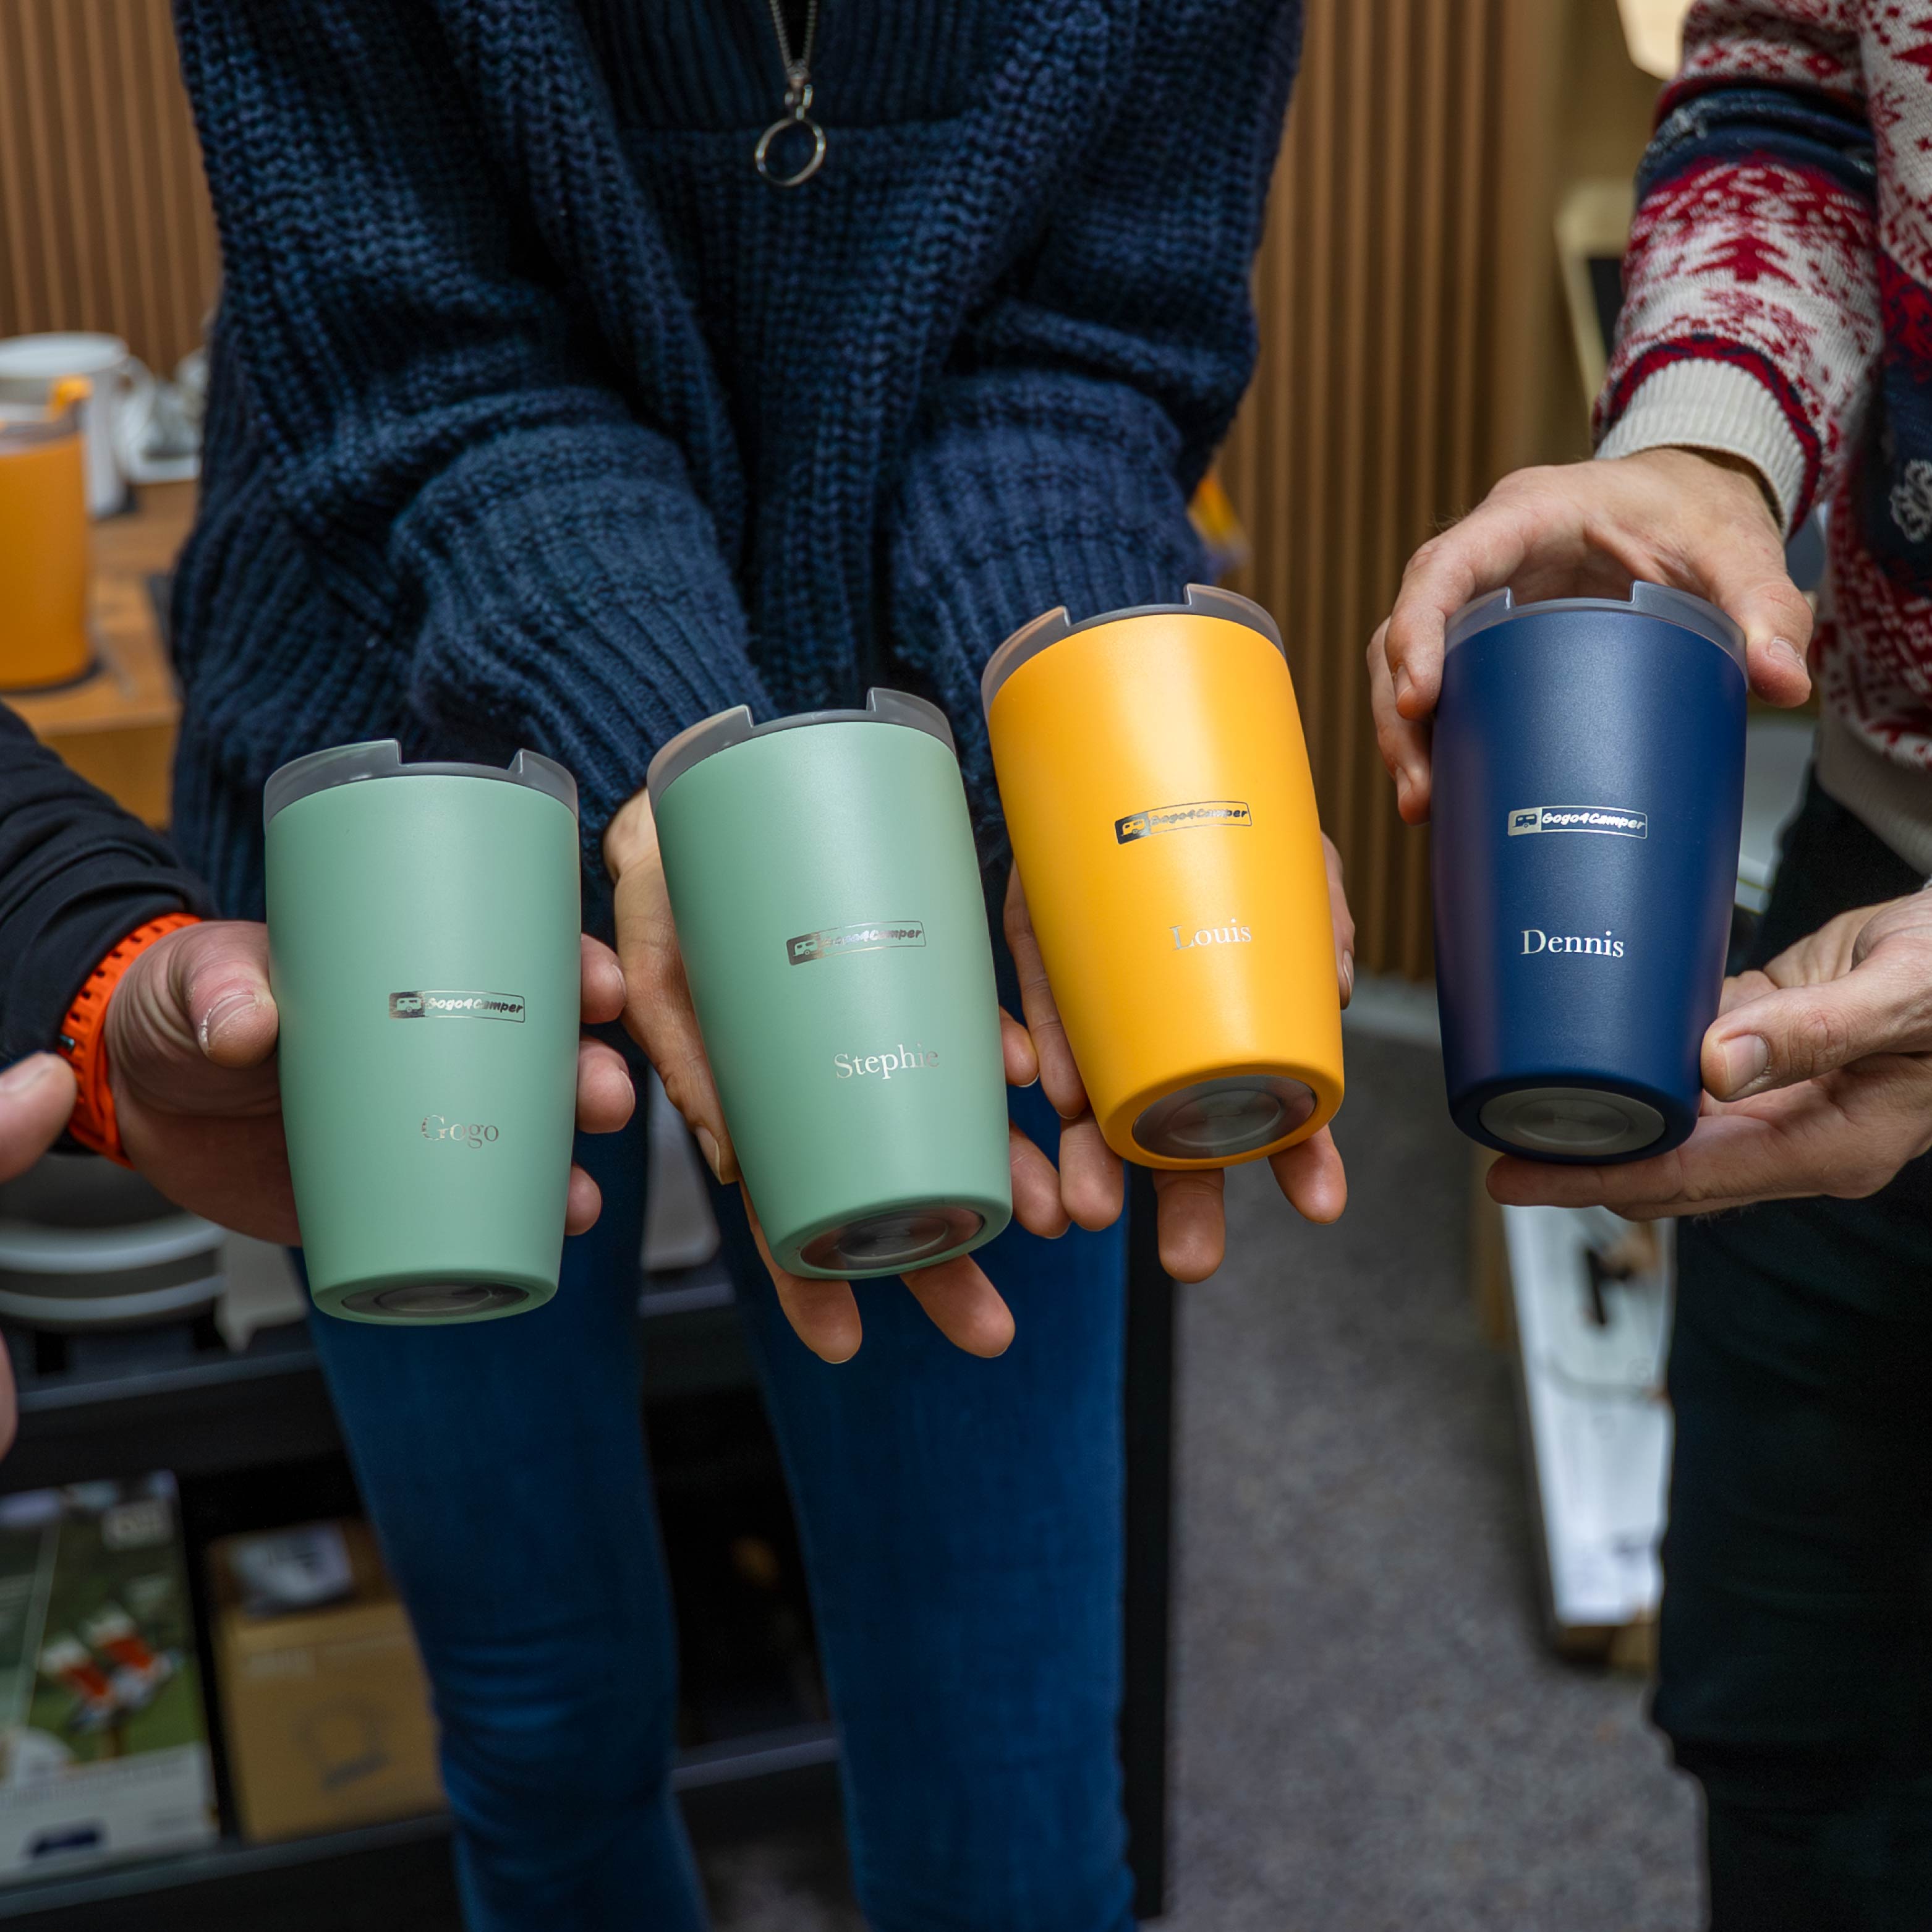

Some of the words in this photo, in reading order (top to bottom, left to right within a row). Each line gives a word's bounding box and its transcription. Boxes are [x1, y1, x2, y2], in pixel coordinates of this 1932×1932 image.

[1542, 812, 1646, 830] Gogo4Camper
[1169, 917, 1252, 951] Louis
[1520, 929, 1624, 958] Dennis
[834, 1043, 940, 1079] Stephie
[421, 1114, 499, 1149] Gogo
